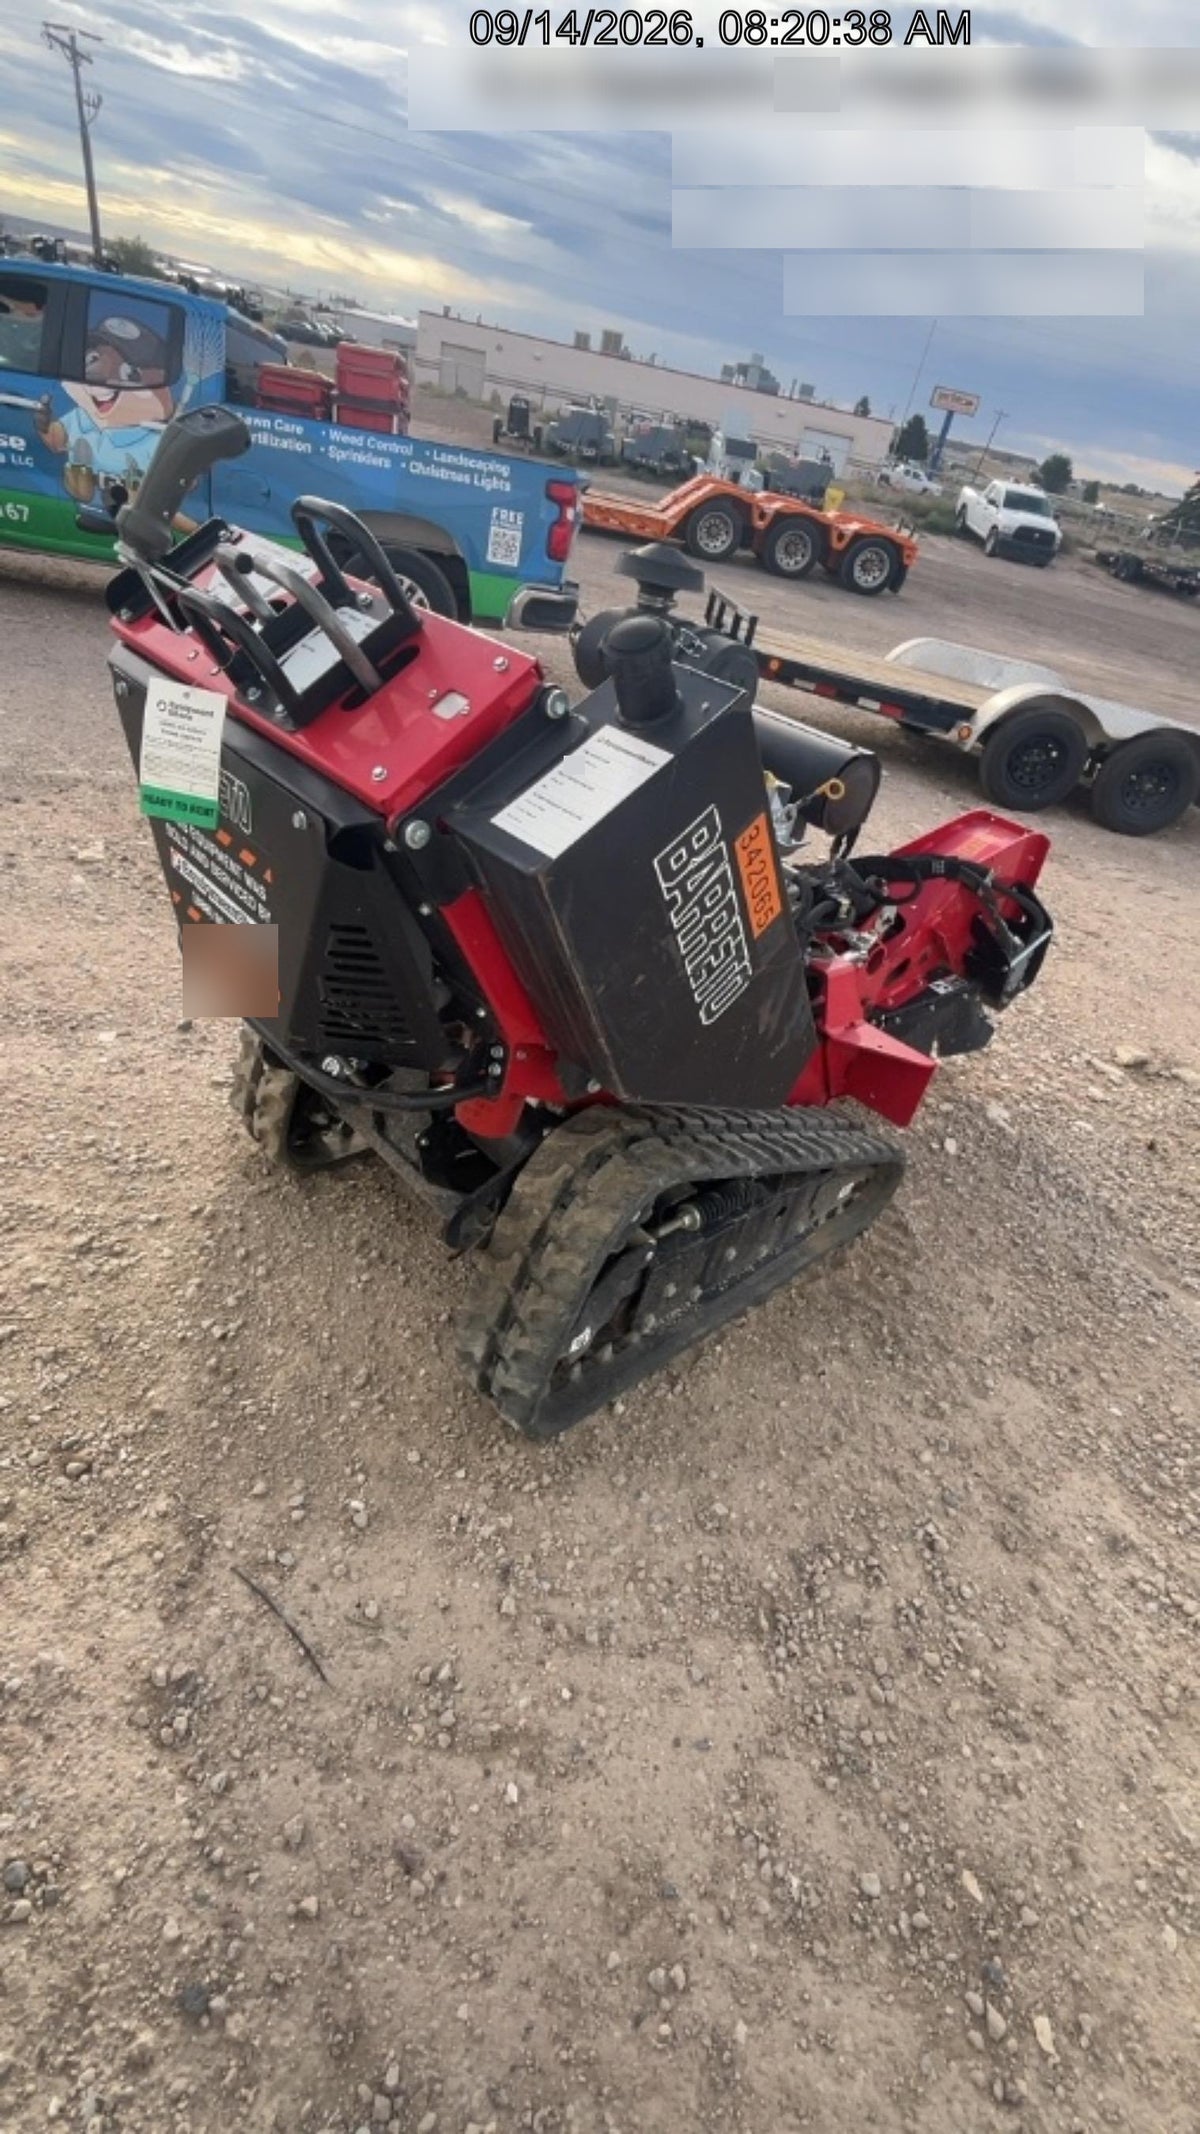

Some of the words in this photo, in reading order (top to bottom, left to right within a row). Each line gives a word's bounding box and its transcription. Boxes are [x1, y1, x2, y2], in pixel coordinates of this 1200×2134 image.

[251, 431, 312, 454] rtilization
[328, 445, 392, 469] Sprinklers
[409, 460, 470, 484] Christmas
[473, 474, 511, 492] Lights
[274, 418, 304, 435] Care
[328, 428, 364, 447] Weed
[367, 436, 414, 456] Control
[433, 449, 511, 477] Landscaping
[0, 502, 29, 522] 67
[492, 507, 524, 525] FREE
[175, 799, 188, 812] TO
[741, 824, 775, 930] 342065
[653, 803, 753, 1025] BARRETO
